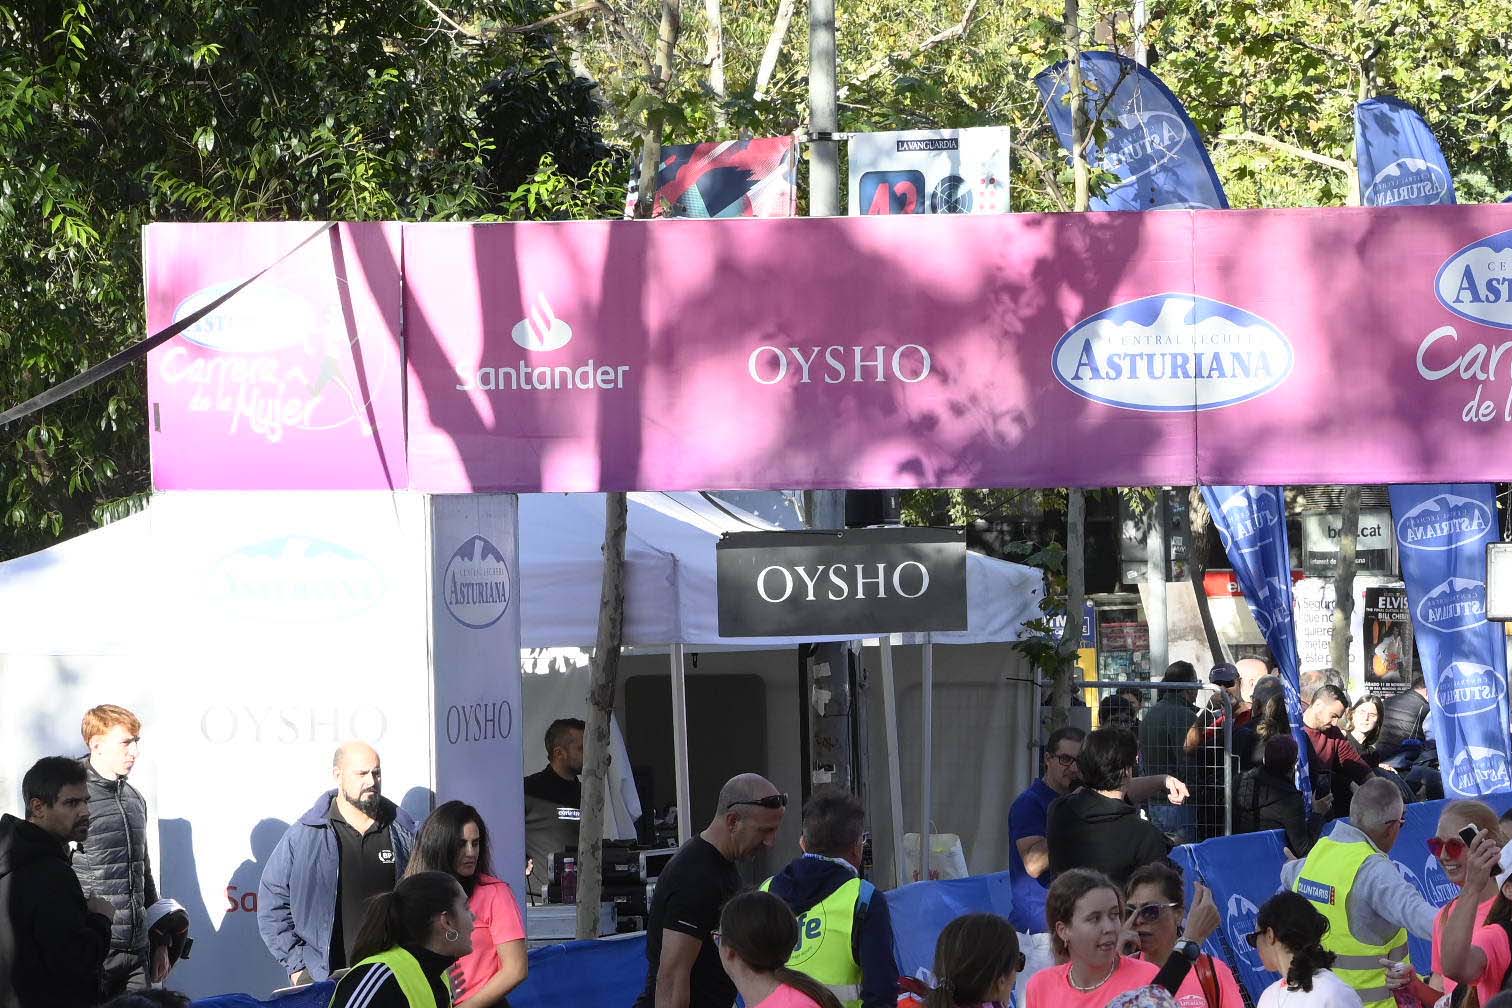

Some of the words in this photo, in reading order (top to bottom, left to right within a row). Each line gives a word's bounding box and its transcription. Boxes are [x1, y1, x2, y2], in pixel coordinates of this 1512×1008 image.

[456, 359, 630, 392] Santander
[748, 344, 931, 385] OYSHO
[1071, 344, 1272, 382] ASTURIANA
[1461, 384, 1497, 423] de
[449, 570, 507, 605] ASTURIANA
[757, 561, 930, 603] OYSHO
[201, 703, 388, 746] OYSHO
[447, 700, 512, 744] OYSHO
